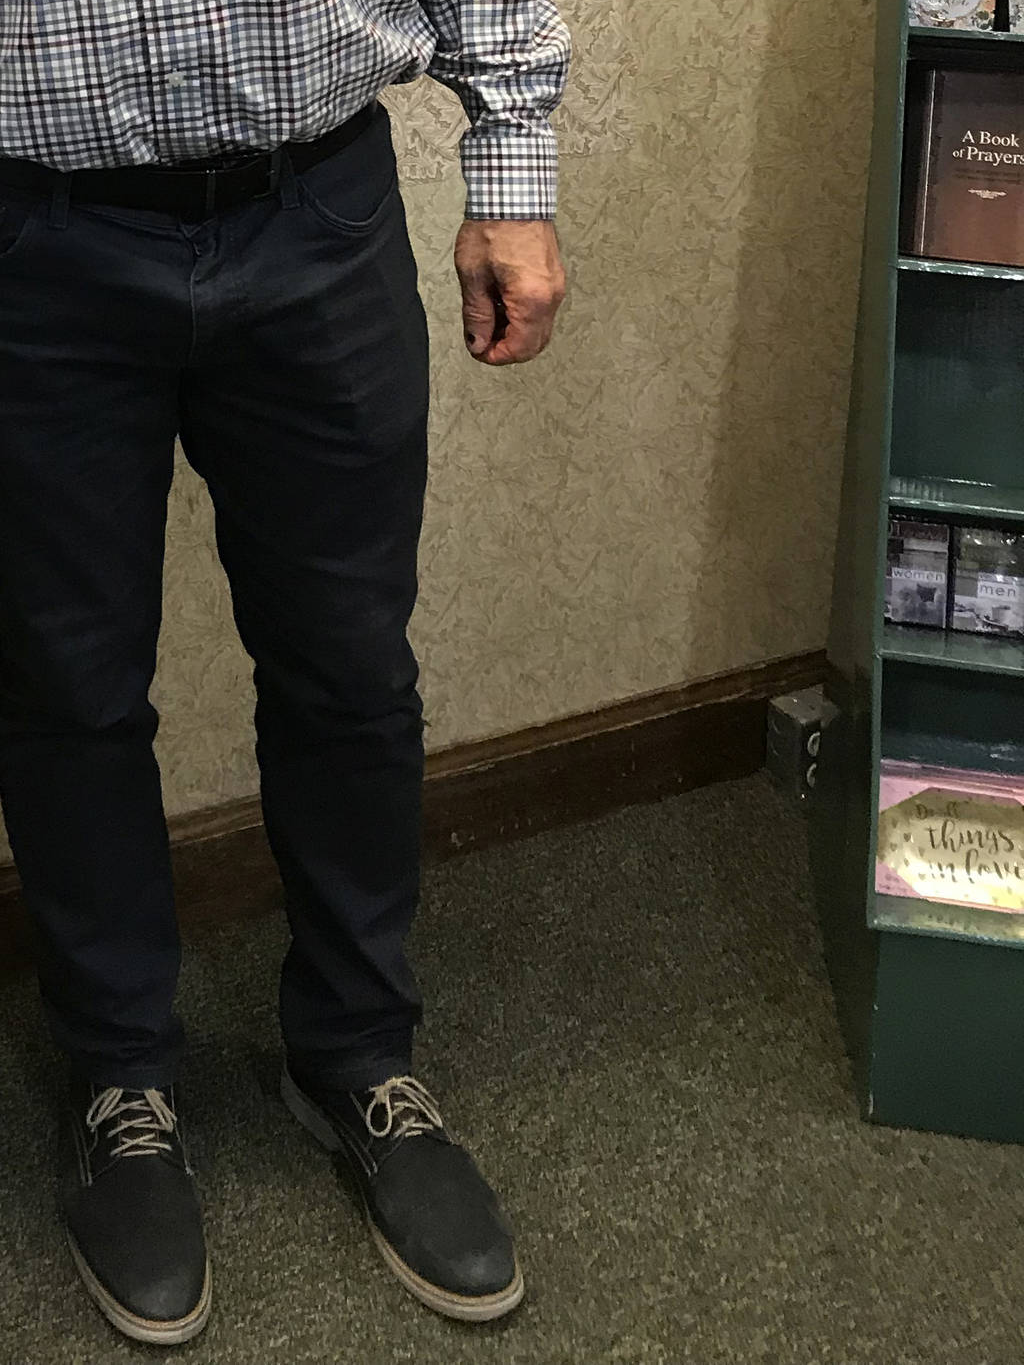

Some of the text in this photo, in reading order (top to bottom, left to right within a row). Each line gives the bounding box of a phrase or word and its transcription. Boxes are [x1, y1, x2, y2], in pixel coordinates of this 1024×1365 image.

[962, 130, 1020, 147] A Book
[952, 146, 1024, 166] of Prayers
[893, 568, 944, 581] women
[979, 584, 1017, 597] men
[926, 819, 1015, 855] things
